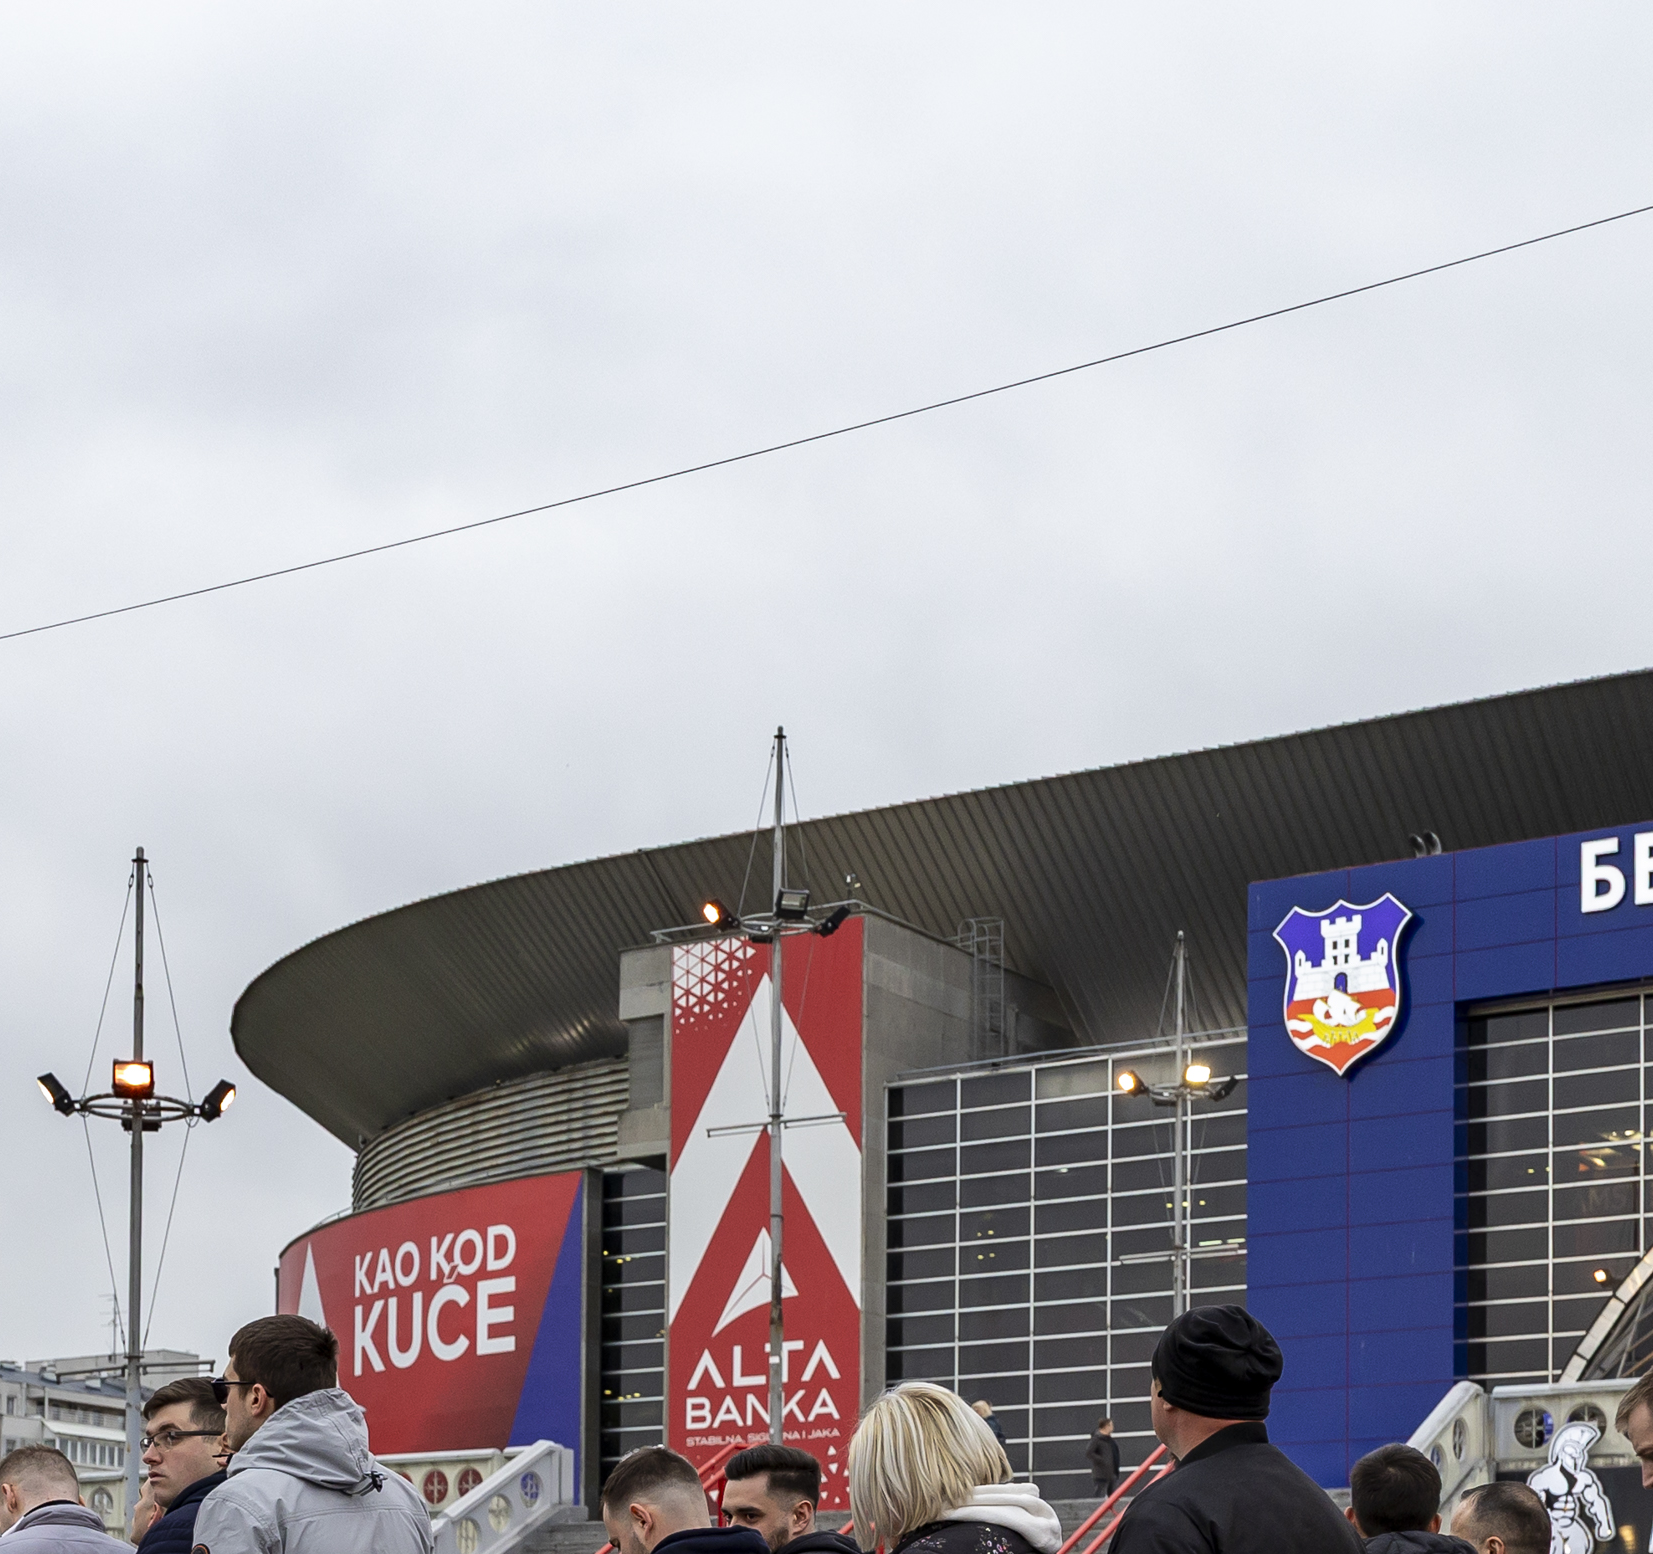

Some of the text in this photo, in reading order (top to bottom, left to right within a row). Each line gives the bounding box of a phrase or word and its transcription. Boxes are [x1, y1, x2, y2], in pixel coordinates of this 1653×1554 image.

[354, 1223, 517, 1298] KAO KOD
[687, 1338, 841, 1391] ALTA
[685, 1387, 841, 1430] BANKA
[808, 1427, 841, 1440] JAKA
